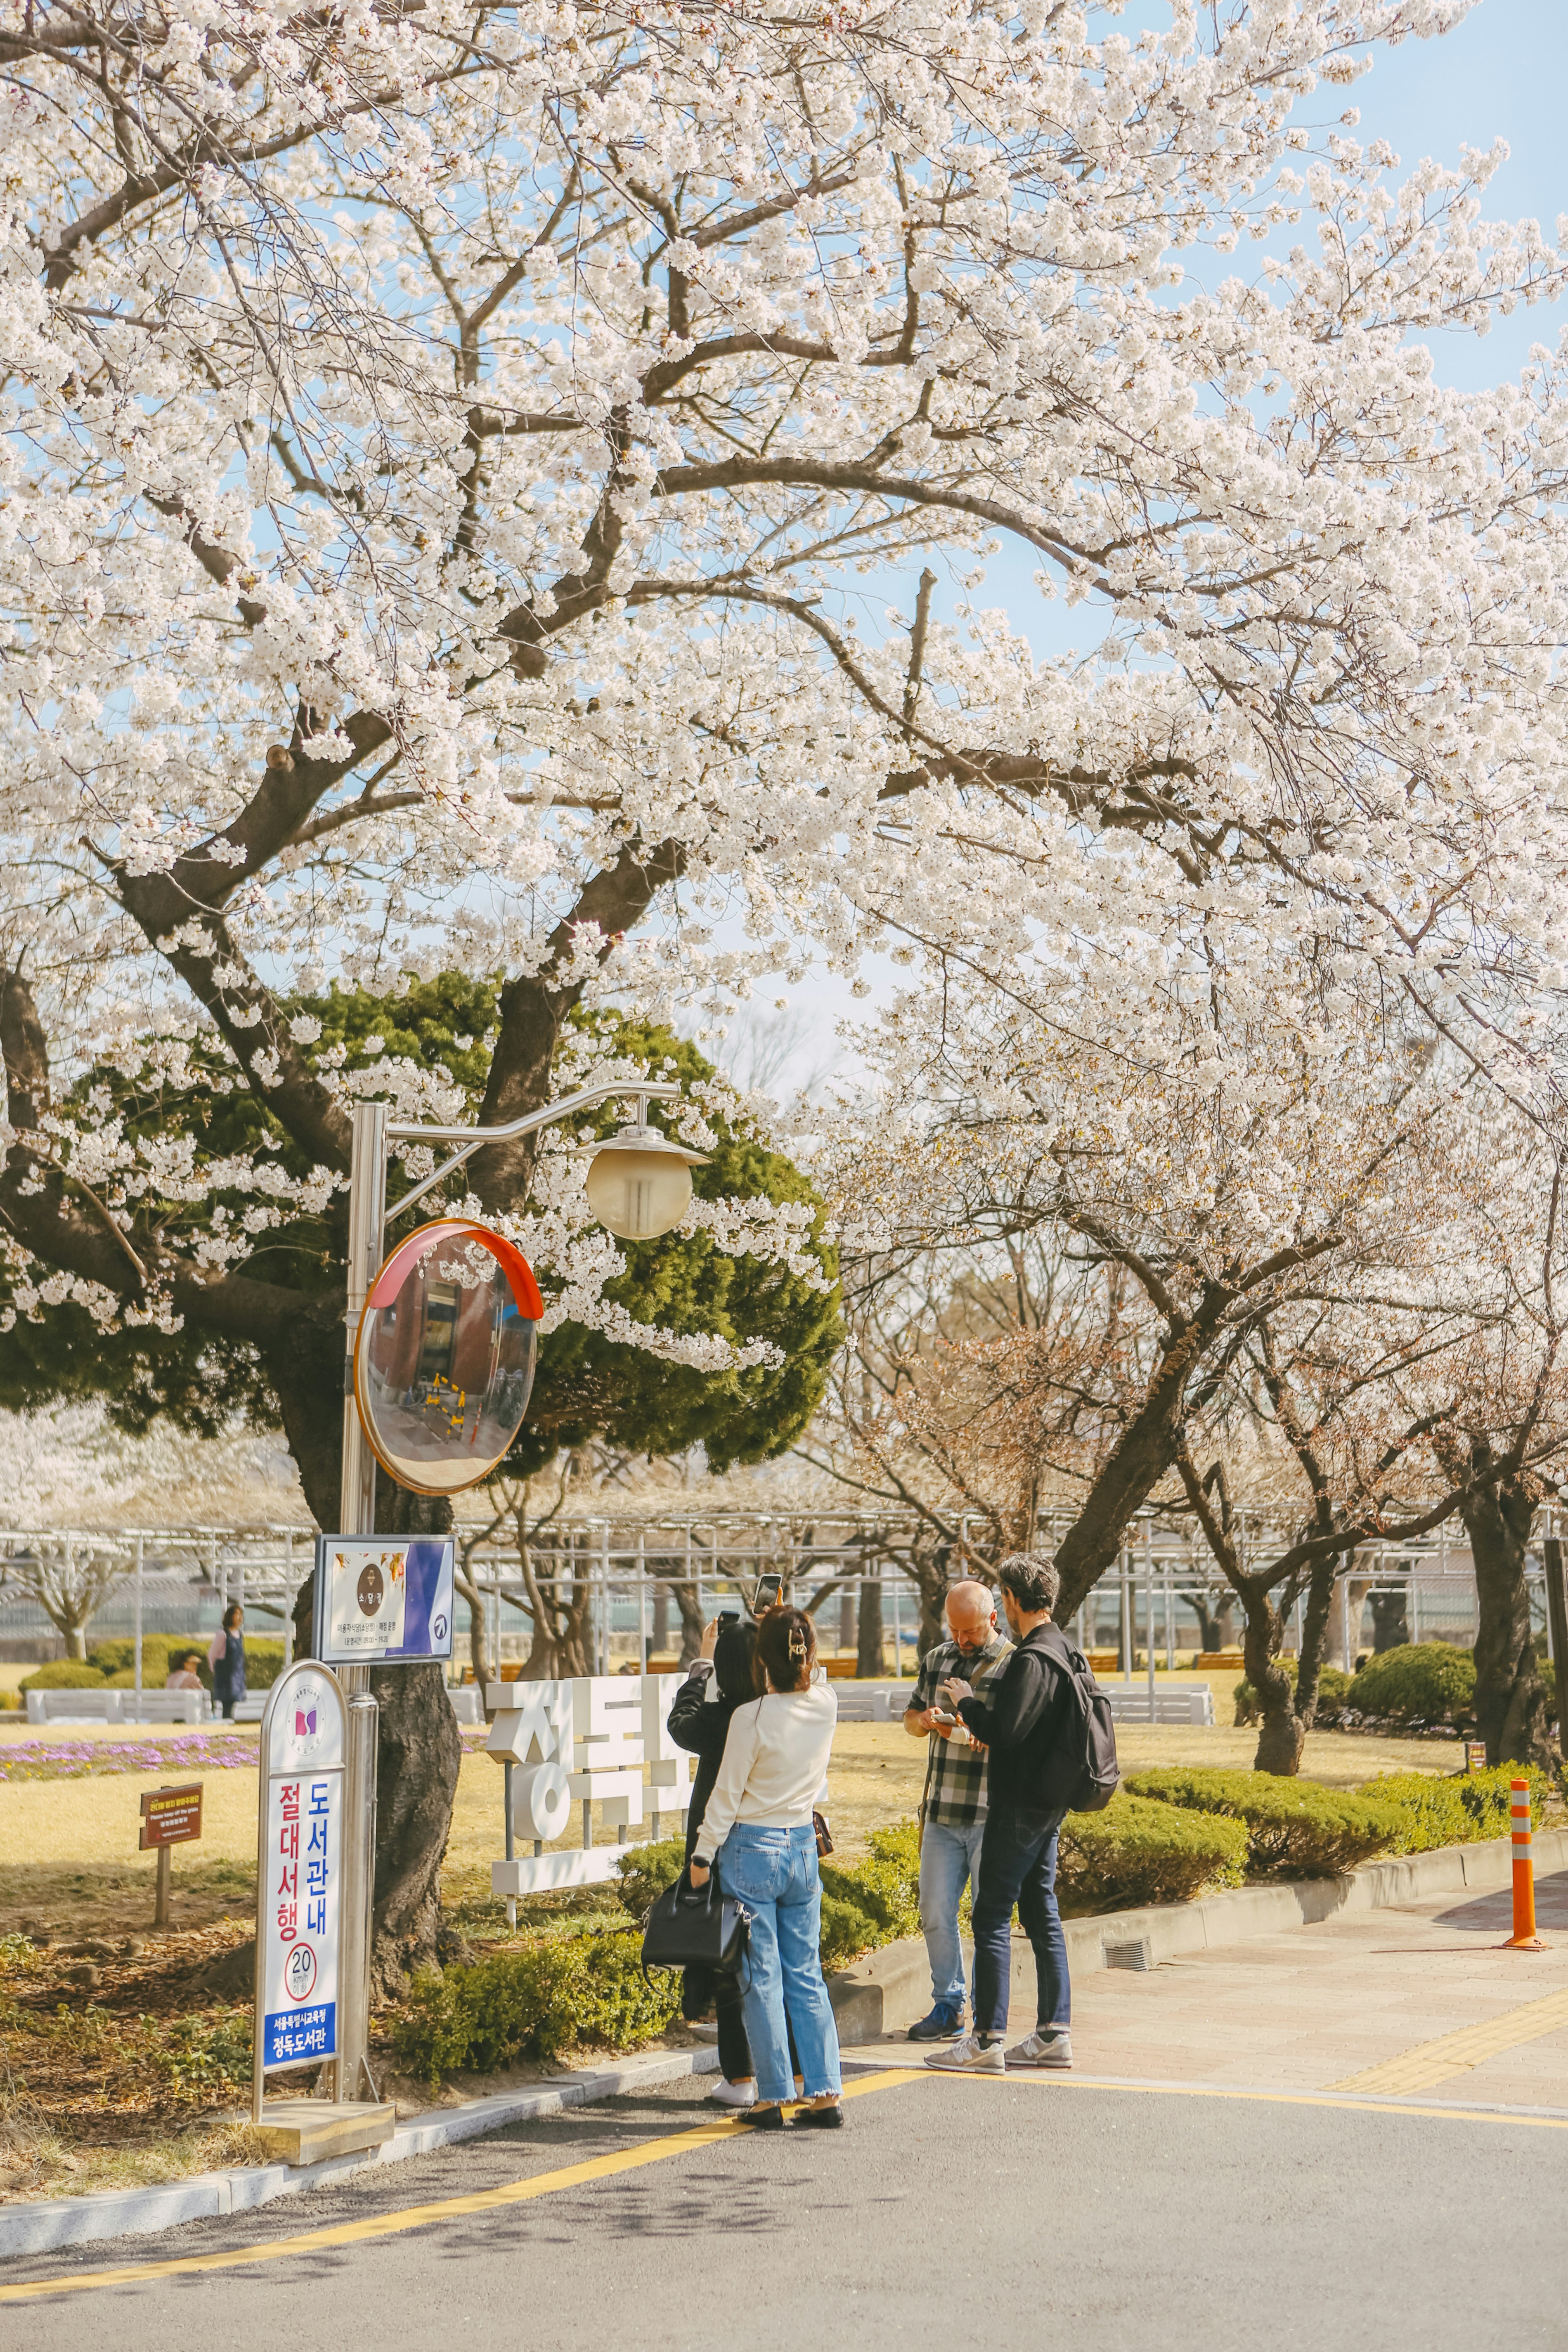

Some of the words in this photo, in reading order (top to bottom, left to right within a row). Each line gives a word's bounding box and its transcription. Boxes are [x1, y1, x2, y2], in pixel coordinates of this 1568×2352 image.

[292, 1950, 311, 1974] 20
[293, 1973, 308, 1984] km/h
[274, 2009, 326, 2031] 서울특별시교육청
[273, 2027, 326, 2059] 정독도서관
